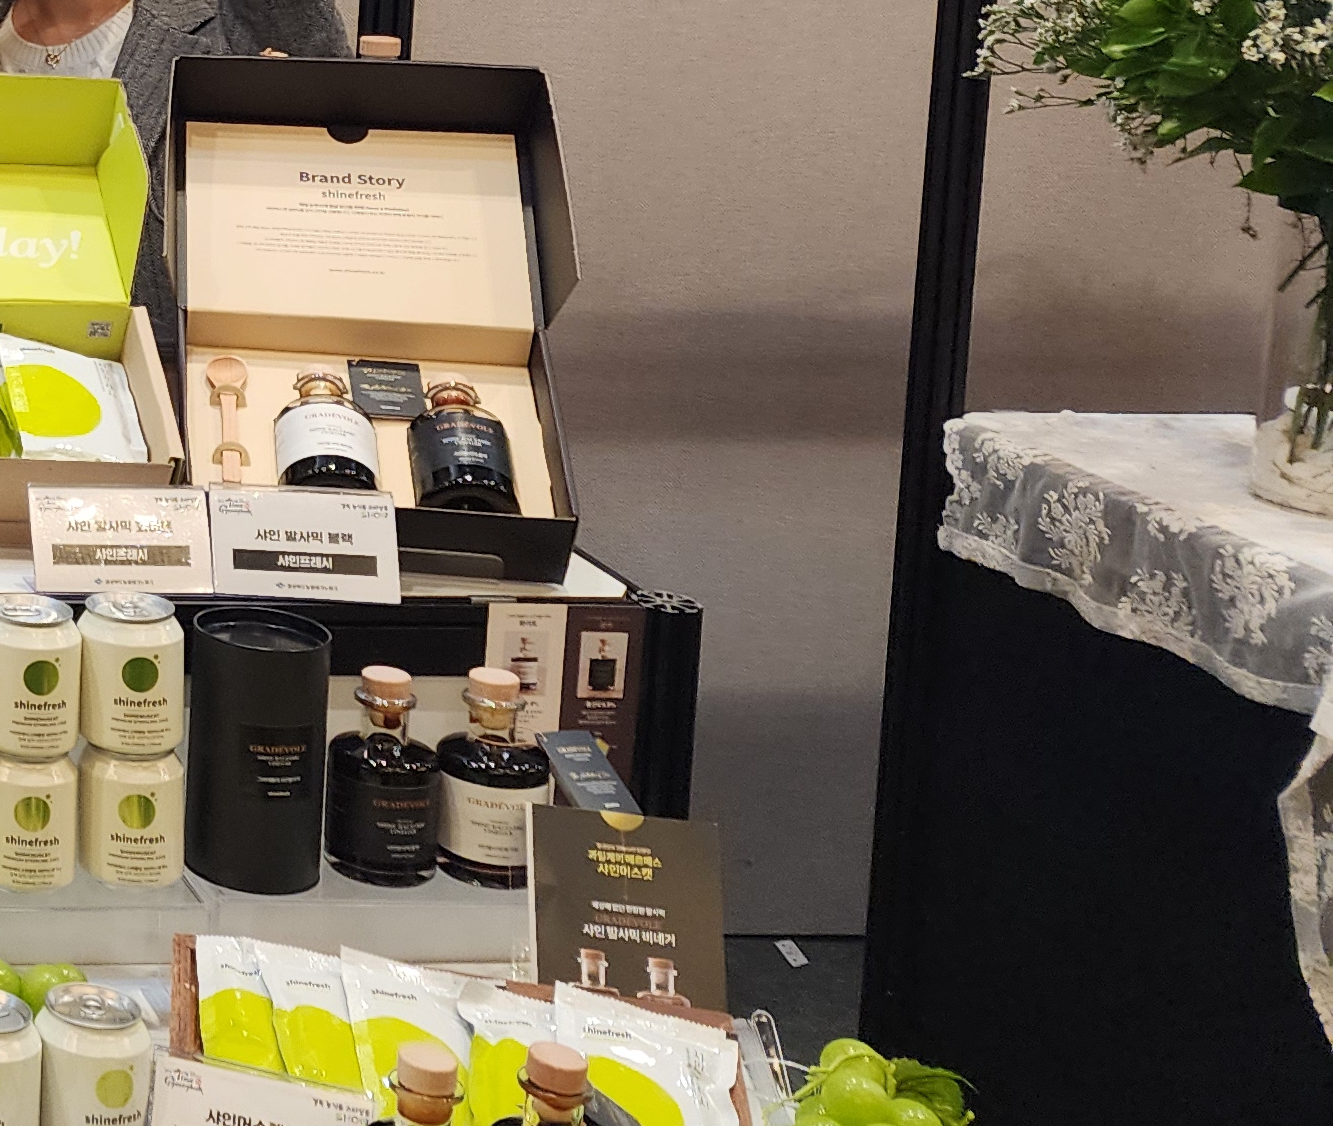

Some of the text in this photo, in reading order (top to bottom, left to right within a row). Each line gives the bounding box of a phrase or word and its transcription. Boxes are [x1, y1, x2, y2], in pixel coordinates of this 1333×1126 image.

[299, 171, 406, 190] Brand Story
[321, 189, 387, 202] shinefresh
[254, 528, 281, 542] 샤인
[277, 553, 334, 570] 샤인프레시
[13, 699, 68, 712] shinefresh
[113, 696, 169, 709] shinefresh
[5, 834, 61, 847] shinefresh
[110, 832, 166, 845] shinefresh
[582, 922, 606, 939] 샤인
[370, 987, 418, 1003] shinefresh
[581, 1024, 633, 1041] shinefresh
[84, 1111, 142, 1125] shinefresh
